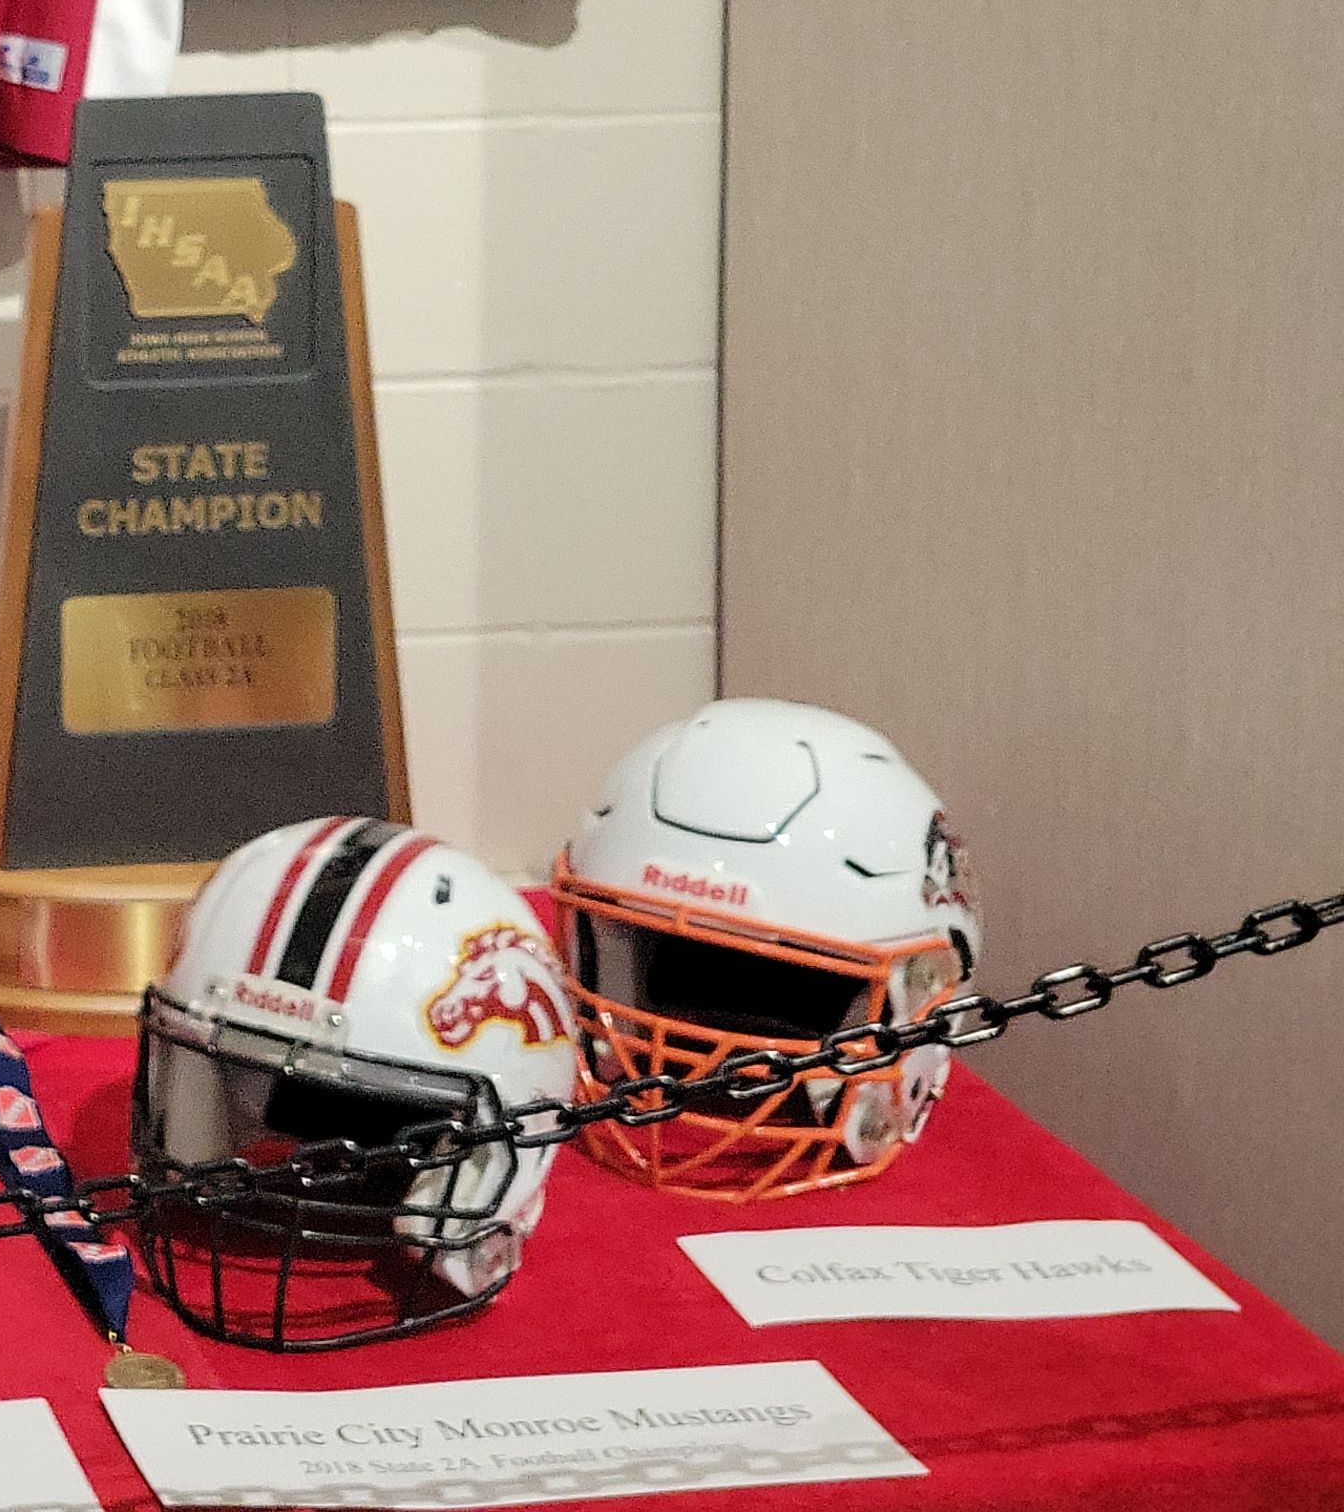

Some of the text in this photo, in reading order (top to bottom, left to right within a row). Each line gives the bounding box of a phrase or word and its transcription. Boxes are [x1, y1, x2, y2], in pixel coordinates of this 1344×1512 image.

[121, 195, 259, 308] IHSAA
[131, 442, 270, 484] STATE
[77, 491, 324, 538] CHAMPION
[642, 862, 750, 906] Riddell
[755, 1253, 1154, 1288] Colfax Tiger Hawks
[187, 1398, 814, 1450] Prairie City Monroe Mustangs
[368, 1456, 434, 1475] State
[439, 1454, 482, 1473] 2A
[490, 1446, 596, 1470] Football
